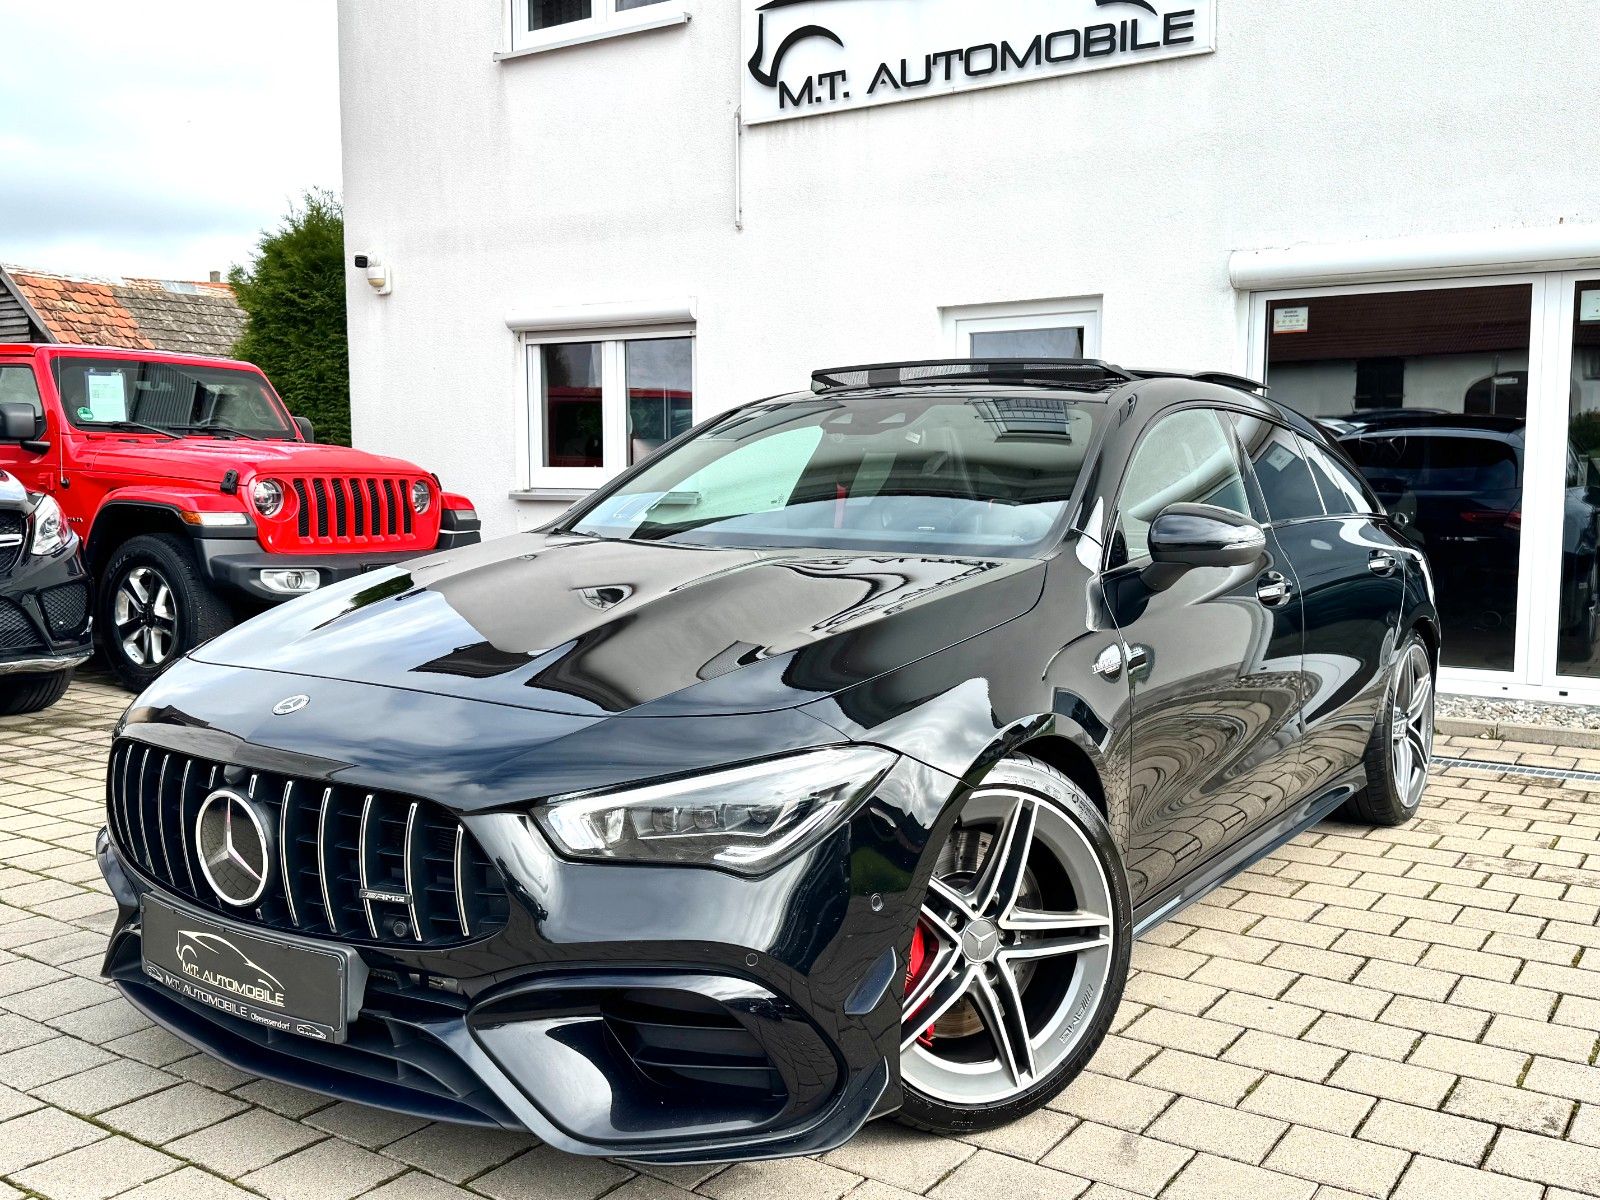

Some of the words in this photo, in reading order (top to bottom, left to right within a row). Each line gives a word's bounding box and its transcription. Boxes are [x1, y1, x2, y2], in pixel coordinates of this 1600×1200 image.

[778, 68, 850, 110] M.T.
[866, 8, 1195, 96] AUTOMOBILE
[183, 984, 248, 1018] AUTOMOBILE
[250, 1012, 291, 1031] Oberessendorf
[203, 970, 285, 1004] AUTOMOBILE
